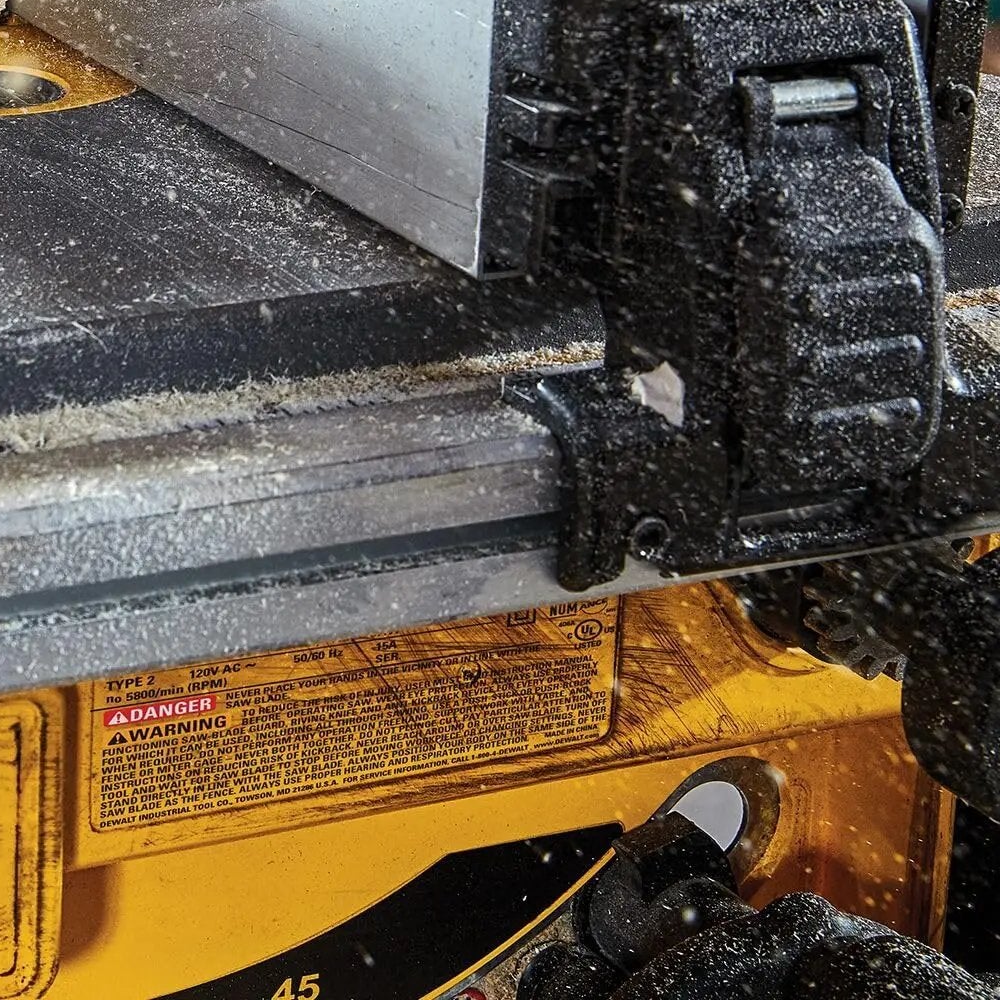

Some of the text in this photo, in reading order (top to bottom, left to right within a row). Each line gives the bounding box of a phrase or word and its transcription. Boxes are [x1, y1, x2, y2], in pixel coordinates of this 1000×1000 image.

[293, 647, 343, 664] 50/60 Hz
[375, 651, 401, 663] SER.
[376, 640, 396, 651] 15A
[574, 639, 602, 650] LISTED
[106, 675, 155, 692] TYPE 2
[189, 662, 240, 679] 120V AC
[125, 683, 183, 702] 5800/min
[187, 676, 227, 693] (RPM)
[225, 687, 261, 700] NEVER
[262, 682, 296, 694] PLACE
[298, 677, 328, 689] YOUR
[130, 696, 211, 722] DANGER
[225, 697, 251, 709] SAW
[241, 691, 362, 717] TO REDUCE OF
[241, 712, 283, 726] BEFORE
[286, 702, 344, 718] OPERATING
[407, 689, 425, 698] EYE
[101, 770, 136, 783] FENCE
[138, 767, 154, 777] OR
[156, 761, 191, 774] MITER
[193, 755, 223, 768] GAGE
[234, 747, 269, 761] NEVER
[271, 742, 299, 754] BOTH
[358, 730, 373, 739] DO
[375, 726, 396, 736] NOT
[461, 711, 482, 721] PAY
[593, 690, 606, 699] TO
[102, 737, 179, 757] FUNCTIONING
[181, 726, 245, 744] SAW-BLADE
[290, 713, 326, 726] RIVING
[328, 708, 358, 720] KNIFE
[359, 704, 382, 714] AND
[102, 755, 123, 766] FOR
[125, 748, 164, 762] WHICH
[166, 746, 177, 755] IT
[179, 742, 203, 753] CAN
[205, 739, 219, 749] BE
[255, 723, 313, 740] INCLUDING
[313, 720, 335, 730] ALL
[334, 712, 384, 727] THROUGH
[128, 714, 226, 743] WARNING
[575, 723, 597, 732] CHINA
[100, 789, 127, 801] TOOL
[131, 784, 156, 795] AND
[157, 778, 187, 791] WAIT
[189, 774, 211, 785] FOR
[213, 769, 239, 781] SAW
[241, 763, 275, 776] BLADE
[276, 760, 291, 770] TO
[293, 755, 320, 767] STOP
[322, 748, 360, 762] BEFORE
[362, 741, 403, 755] MOVING
[477, 719, 528, 734] CHANGING
[577, 705, 606, 717] NEVER
[101, 771, 182, 792] INSTRUCTIONS
[184, 767, 202, 778] ON
[203, 758, 257, 774] REDUCING
[259, 753, 283, 764] RISK
[285, 751, 299, 760] OF
[356, 735, 388, 748] NEVER
[390, 729, 425, 742] REACH
[424, 722, 464, 736] AROUND
[466, 719, 480, 728] OR
[482, 715, 506, 726] OVER
[507, 711, 530, 721] SAW
[565, 701, 589, 711] TURN
[591, 698, 607, 707] OFF
[101, 761, 137, 774] WHEN
[198, 748, 214, 758] DO
[217, 744, 241, 755] NOT
[241, 735, 292, 751] PERFORM
[292, 731, 316, 742] ANY
[99, 795, 138, 809] STAND
[140, 786, 190, 802] DIRECTLY
[192, 784, 205, 793] IN
[207, 779, 230, 790] LINE
[232, 774, 260, 786] WITH
[263, 770, 282, 780] THE
[284, 765, 309, 777] SAW
[347, 751, 389, 765] ALWAYS
[391, 743, 436, 758] POSITION
[438, 738, 464, 749] YOUR
[465, 733, 491, 744] BODY
[493, 730, 507, 739] ON
[509, 727, 526, 737] THE
[527, 722, 554, 733] SAME
[555, 718, 575, 728] SIDE
[577, 716, 588, 724] OF
[590, 713, 606, 722] THE
[99, 806, 125, 818] SAW
[127, 800, 161, 813] BLADE
[164, 797, 178, 807] AS
[181, 793, 200, 804] THE
[238, 779, 281, 793] ALWAYS
[283, 775, 302, 785] USE
[304, 768, 341, 781] PROPER
[343, 760, 385, 774] HEARING
[387, 756, 408, 766] AND
[410, 745, 471, 762] RESPIRATORY
[99, 815, 136, 828] DEWALT
[138, 805, 190, 821] INDUSTRIAL
[193, 801, 214, 811] TOOL
[276, 787, 291, 796] MD
[315, 778, 339, 789] U.S.A.
[342, 775, 358, 784] FOR
[359, 769, 392, 781] SERVICE
[450, 755, 469, 764] CALL
[271, 973, 320, 1000] 45
